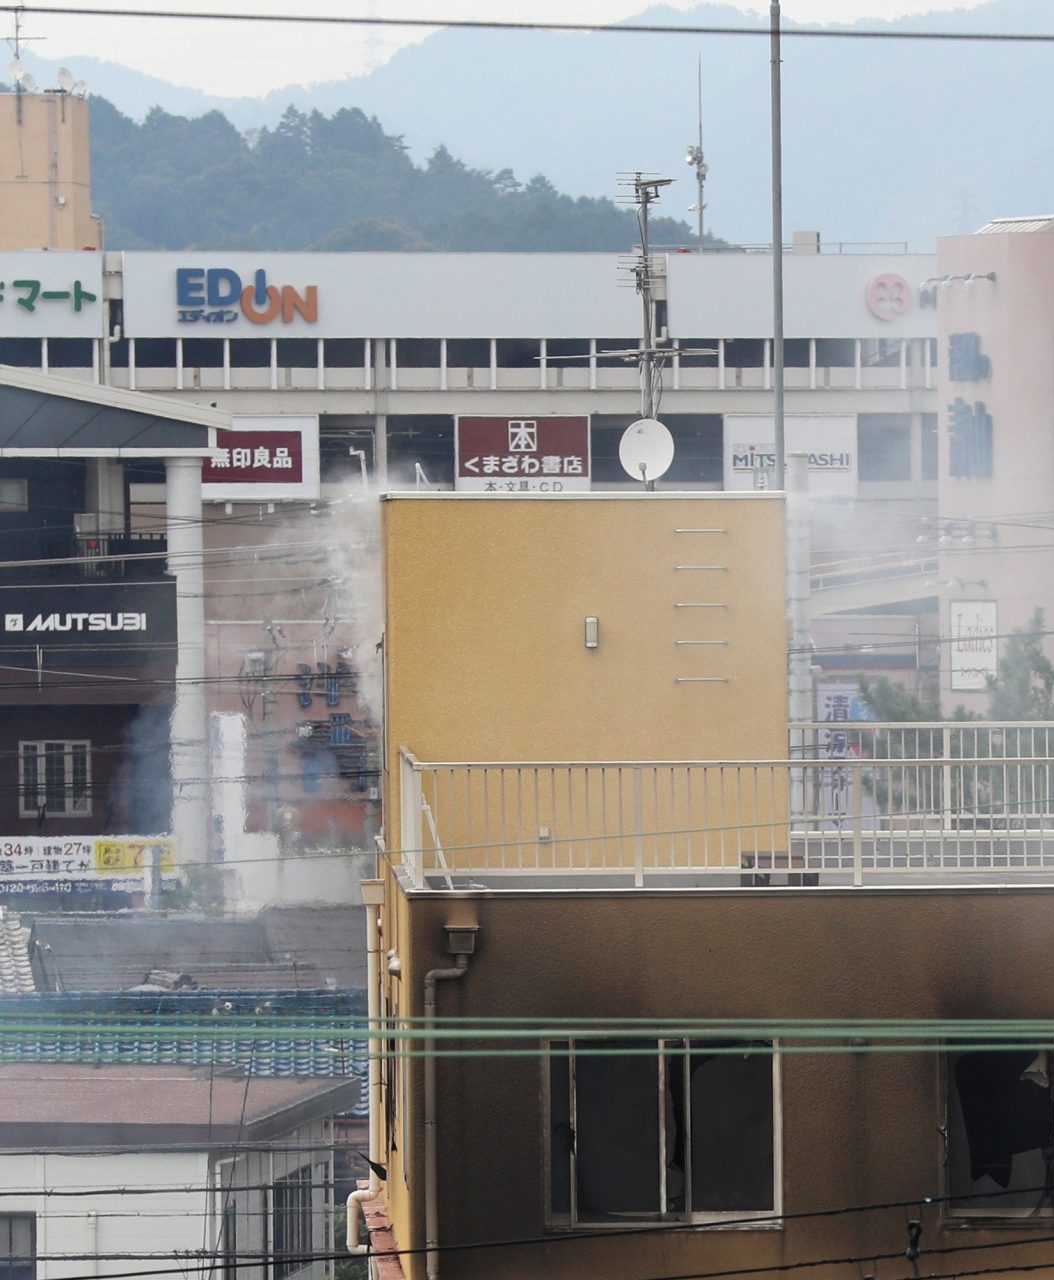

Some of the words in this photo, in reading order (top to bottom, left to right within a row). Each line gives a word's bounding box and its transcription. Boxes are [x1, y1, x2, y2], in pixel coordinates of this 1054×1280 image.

[176, 268, 318, 325] EDION
[211, 446, 293, 469] 無印良品
[464, 455, 583, 474] くまざわ書店
[26, 612, 147, 631] MUTSUBI
